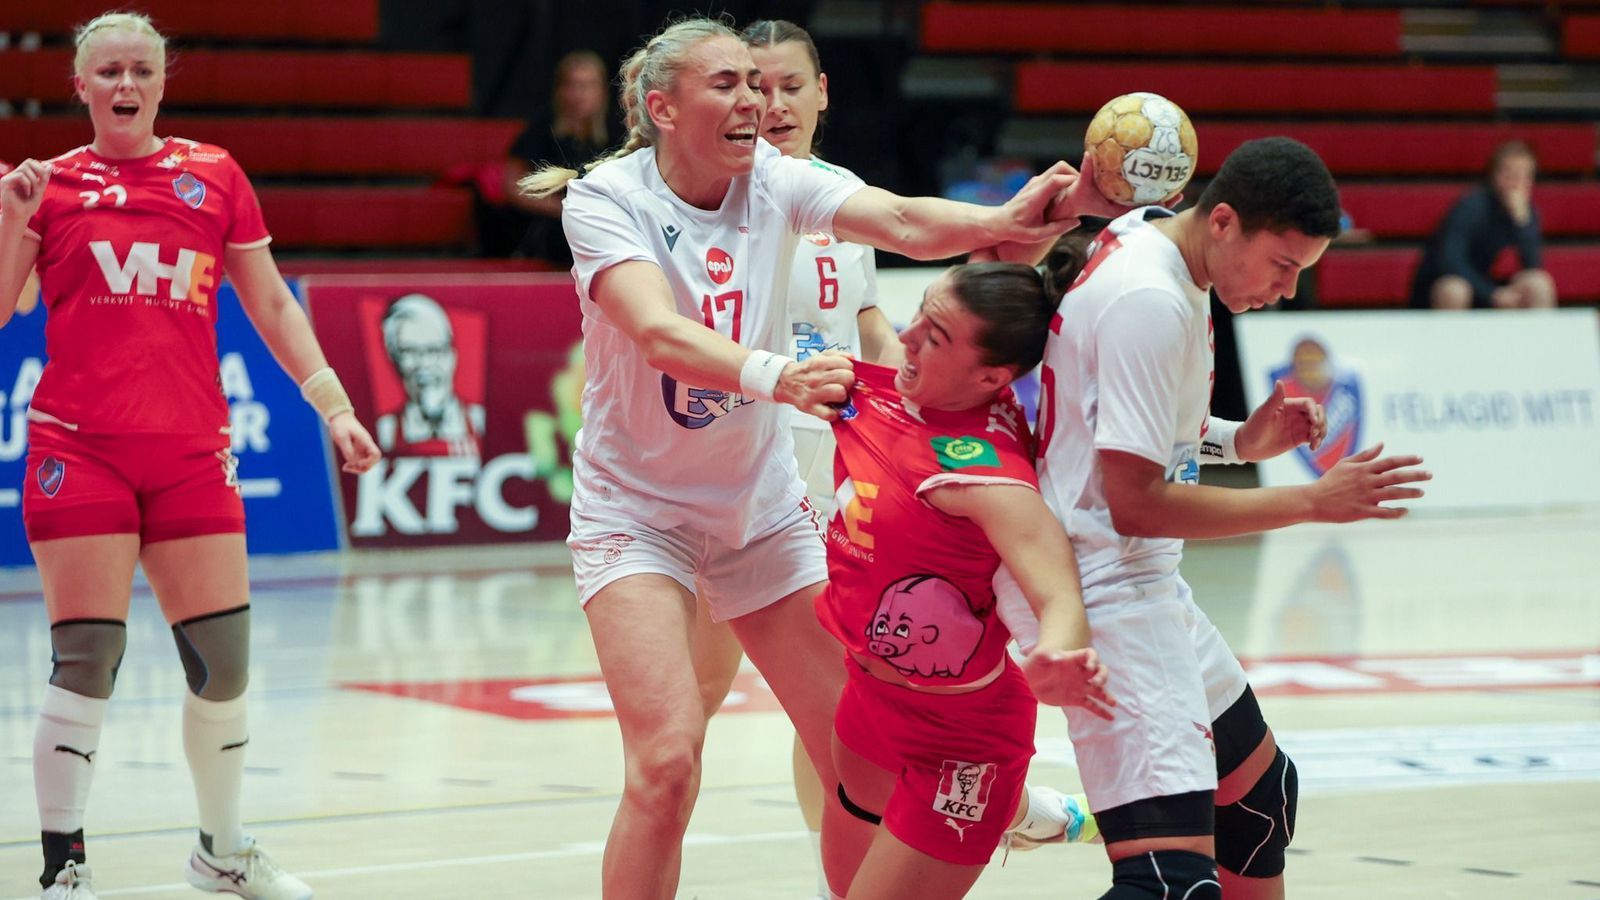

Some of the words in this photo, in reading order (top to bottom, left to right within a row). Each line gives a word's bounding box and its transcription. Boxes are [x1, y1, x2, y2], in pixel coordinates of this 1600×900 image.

[1128, 159, 1189, 181] SELECT
[88, 240, 216, 305] VHE
[707, 256, 732, 276] epal
[815, 256, 839, 310] 6
[701, 290, 743, 344] 17
[351, 453, 538, 536] KFC
[941, 799, 978, 818] KFC
